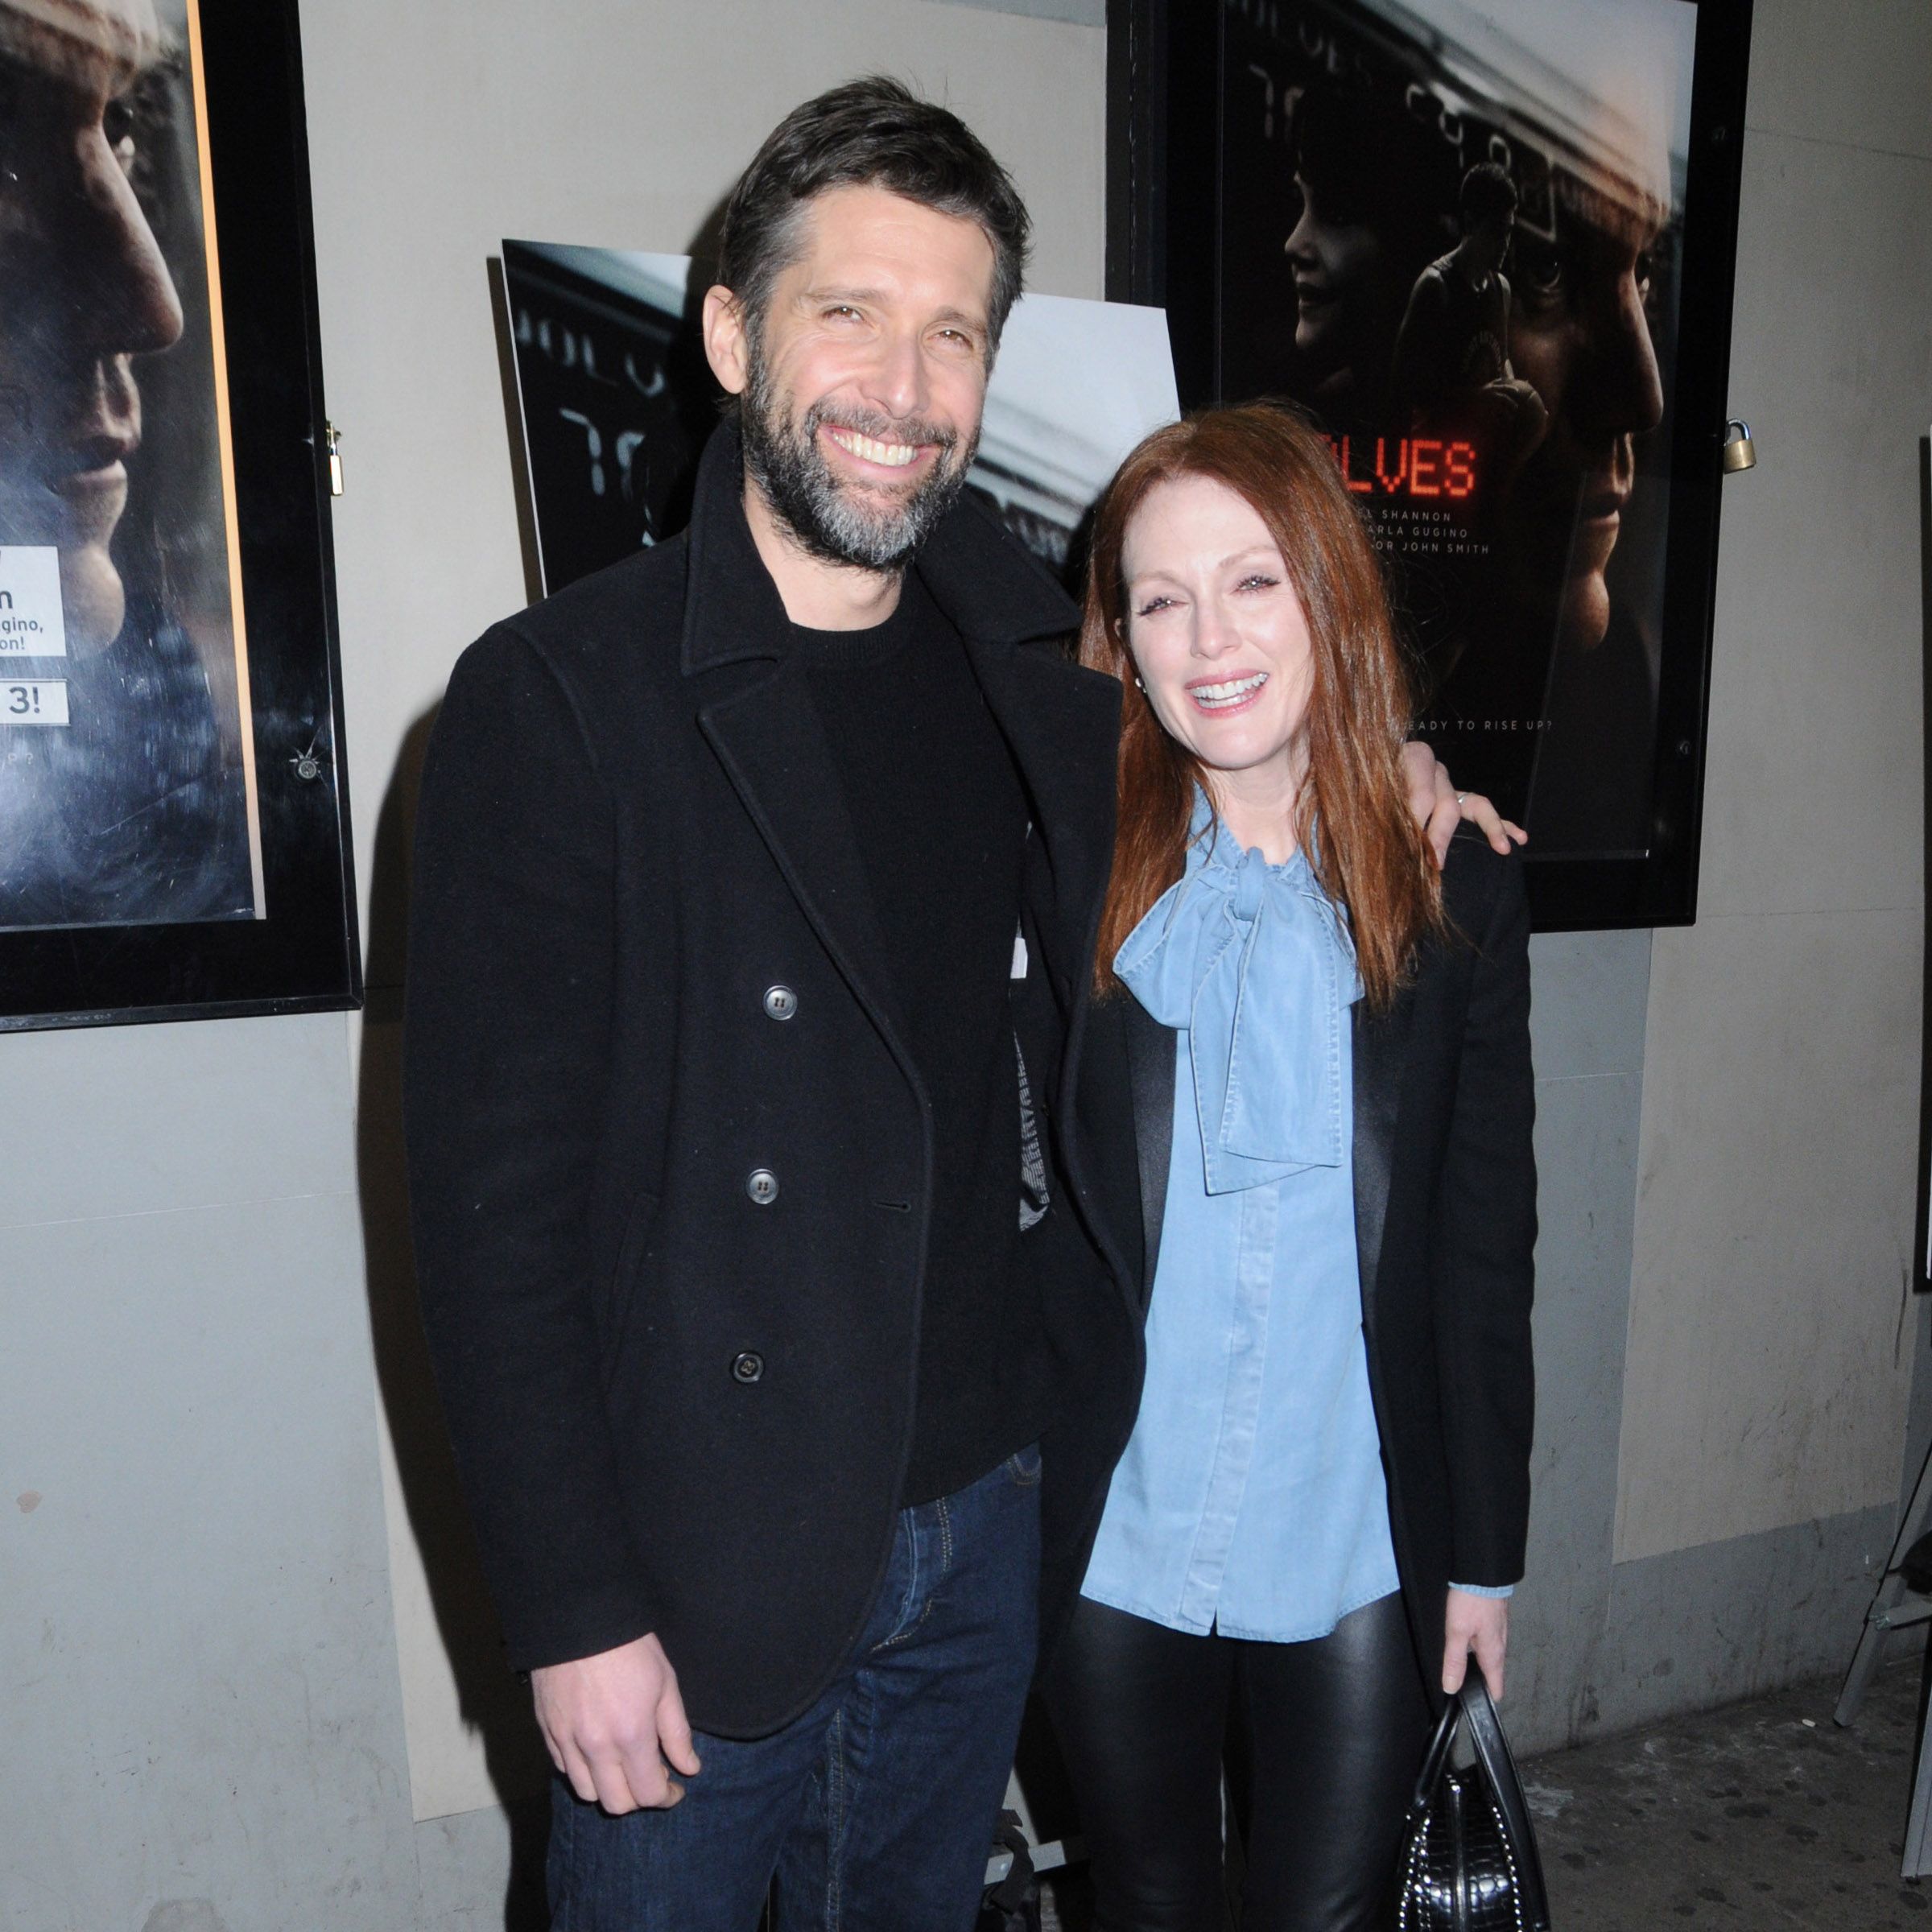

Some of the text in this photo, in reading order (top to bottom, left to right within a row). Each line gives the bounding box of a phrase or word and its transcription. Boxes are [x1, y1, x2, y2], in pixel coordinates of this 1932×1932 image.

[1321, 433, 1476, 498] LVES
[1381, 509, 1451, 522] SHANNON
[1412, 526, 1468, 539] GUGINO
[1402, 541, 1439, 553] JOHN
[1447, 543, 1490, 555] SMITH
[9, 686, 40, 714] 3!
[1404, 720, 1553, 731] EADY TO RISE UP?
